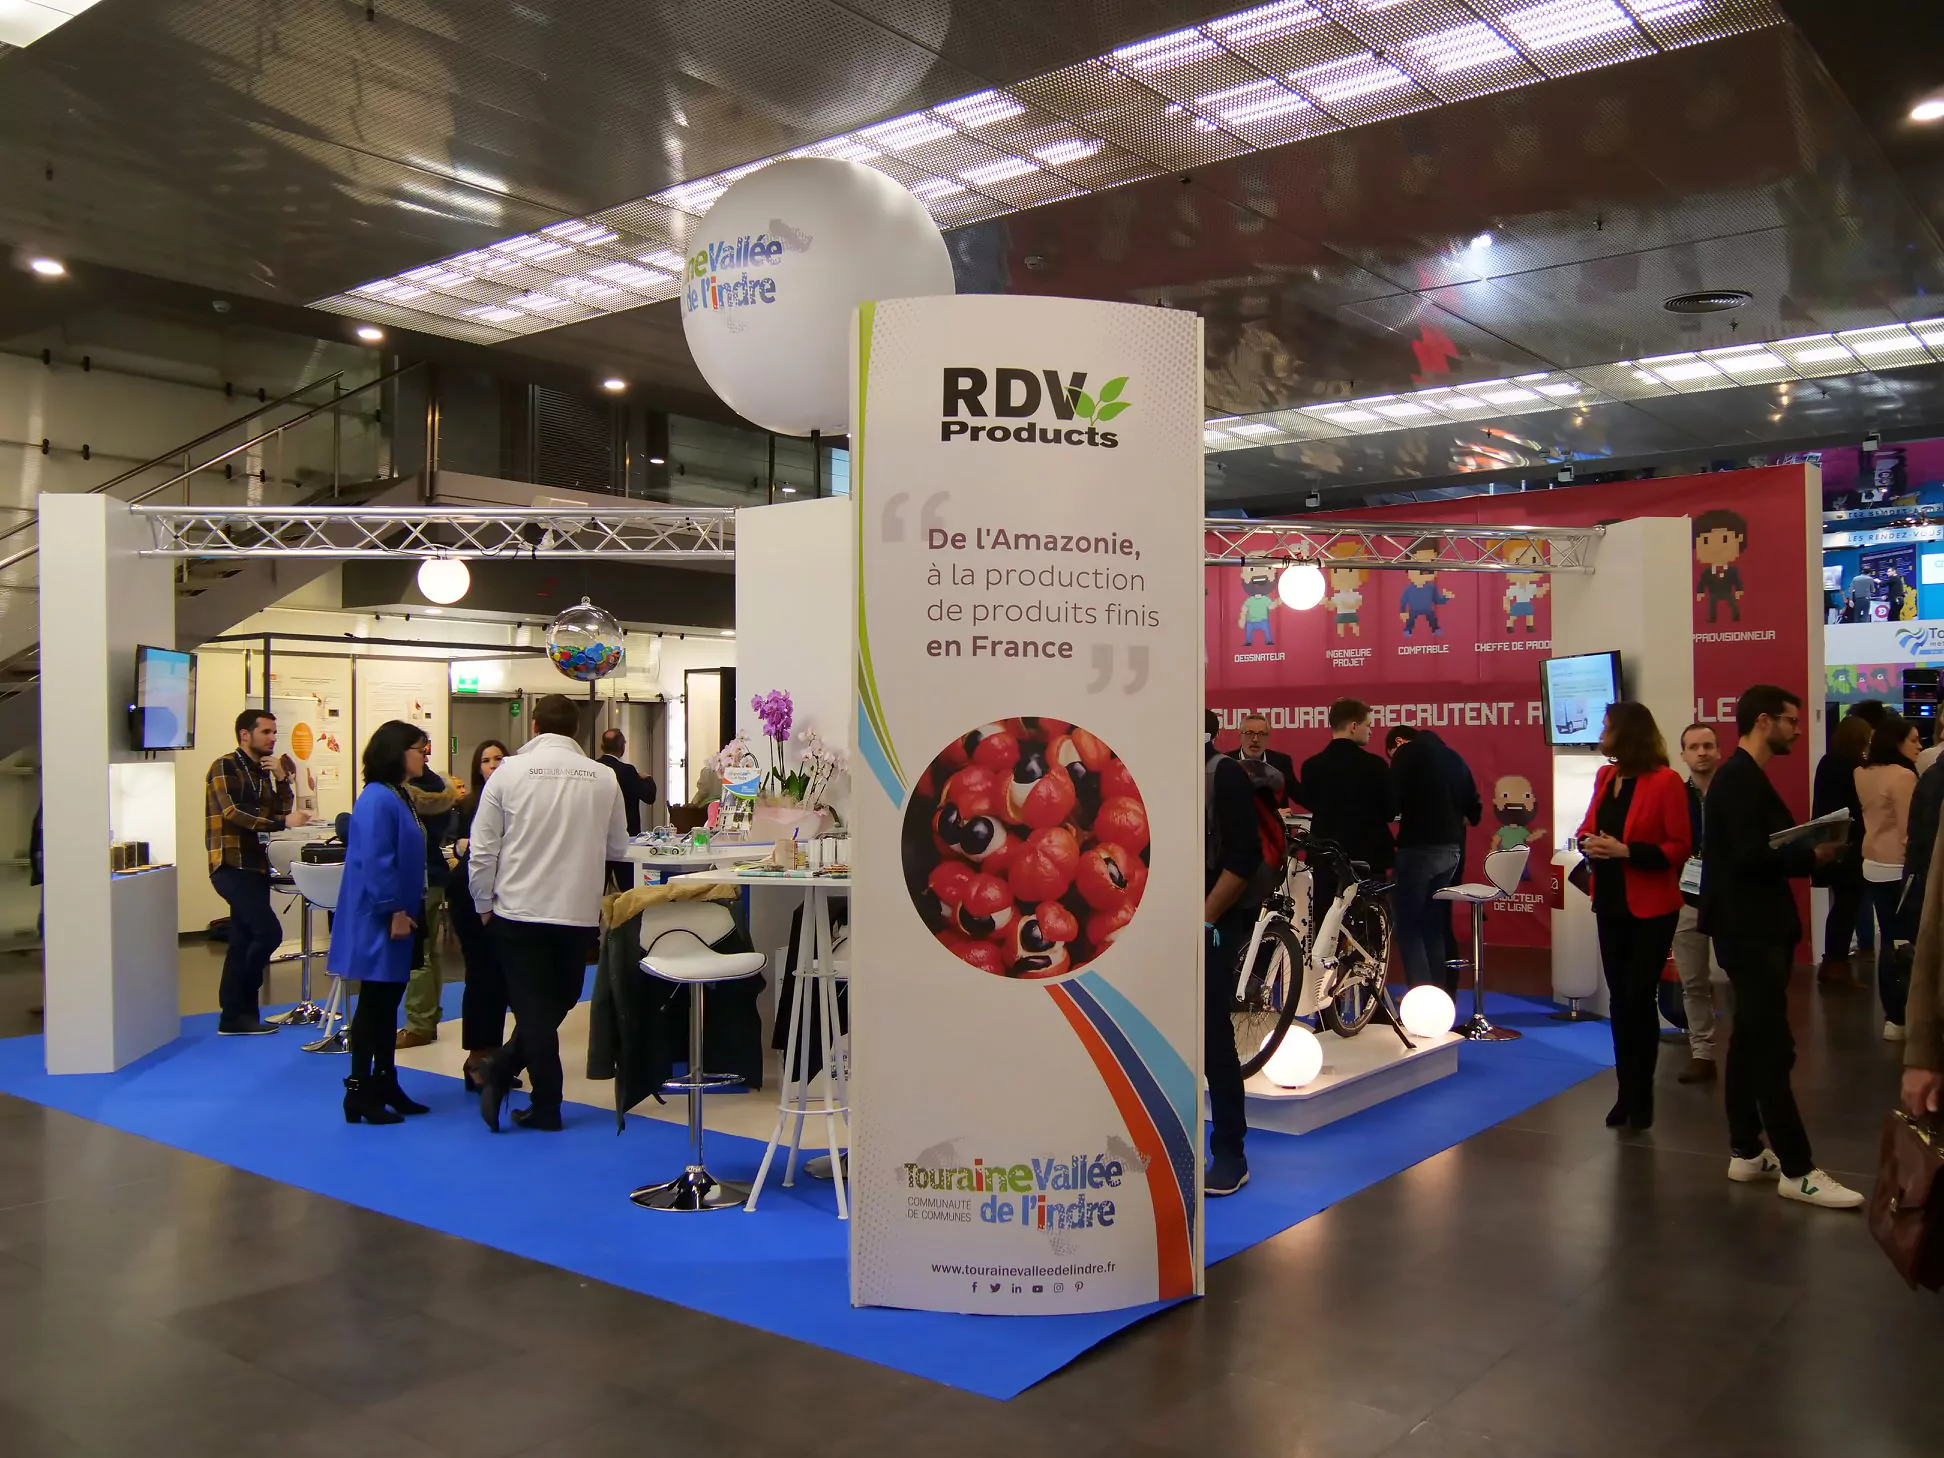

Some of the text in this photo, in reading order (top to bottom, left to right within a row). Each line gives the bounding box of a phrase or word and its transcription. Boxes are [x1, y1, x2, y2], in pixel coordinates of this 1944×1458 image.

[942, 367, 1088, 421] RDV
[941, 420, 1119, 448] Products
[928, 528, 1141, 561] De l'Amazonie,
[1869, 529, 1941, 541] RENDEZ-VOUS
[927, 563, 1145, 591] à la production
[927, 600, 1160, 627] de produits finis
[926, 636, 1073, 659] en France
[1398, 645, 1449, 655] COMPTABLE
[1474, 642, 1510, 652] CHEFFE
[1511, 641, 1524, 650] DE
[1234, 652, 1286, 662] DESSINATEUR
[1333, 658, 1364, 667] PROJET
[1257, 706, 1332, 729] TOURA
[1369, 702, 1520, 728] RECRUTENT.
[1493, 902, 1534, 912] DE LIGNE
[907, 1209, 971, 1222] DE COMMUNES
[980, 1194, 1014, 1223] de
[931, 1261, 1116, 1277] www.tourainevalleedelindre.fr
